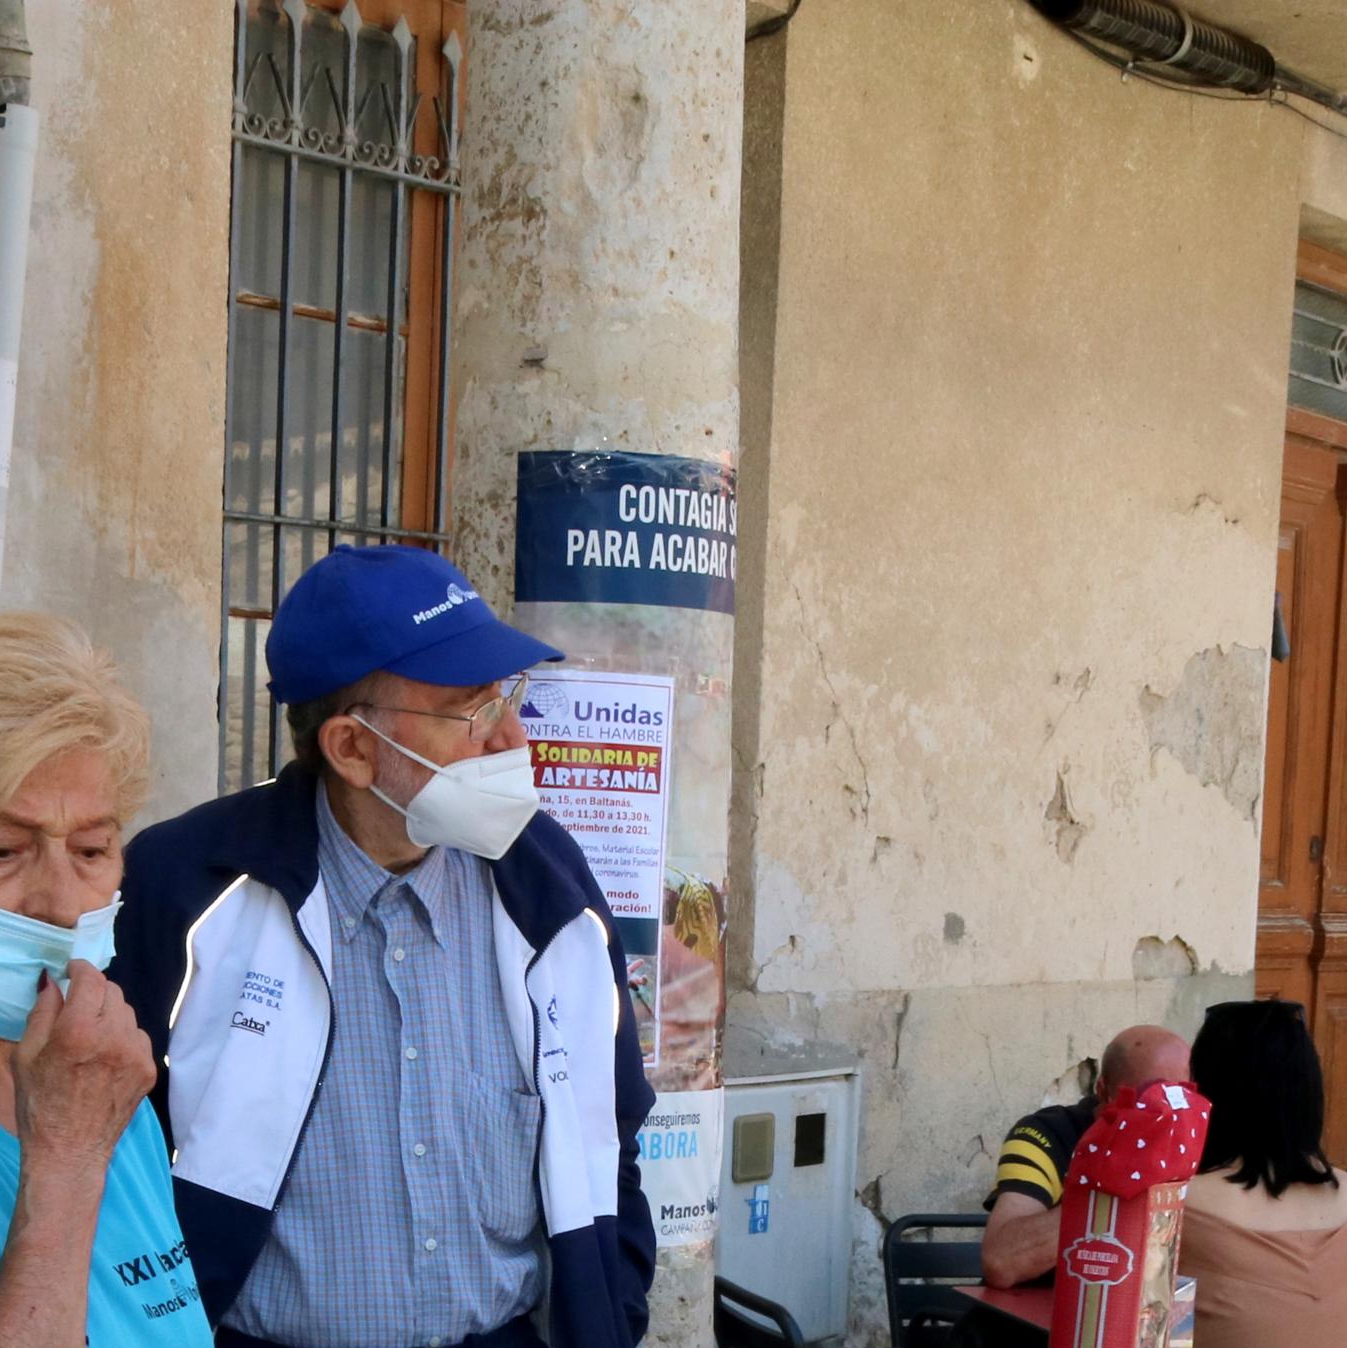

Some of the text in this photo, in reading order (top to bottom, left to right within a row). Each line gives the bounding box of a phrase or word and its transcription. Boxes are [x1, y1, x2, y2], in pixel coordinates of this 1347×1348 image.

[619, 484, 727, 533] CONTAGIA
[566, 529, 641, 569] PARA
[649, 533, 727, 578] ACABAR
[413, 600, 453, 625] Manos
[574, 701, 663, 727] Unidas
[578, 726, 593, 739] EL
[600, 727, 662, 744] HAMBRE
[637, 751, 657, 768] DE
[541, 765, 658, 791] ARTESANÍA
[575, 797, 587, 806] en
[563, 808, 574, 818] de
[612, 824, 624, 835] de
[606, 889, 639, 900] modo
[661, 1202, 706, 1220] Manos
[112, 1254, 157, 1287] XXI
